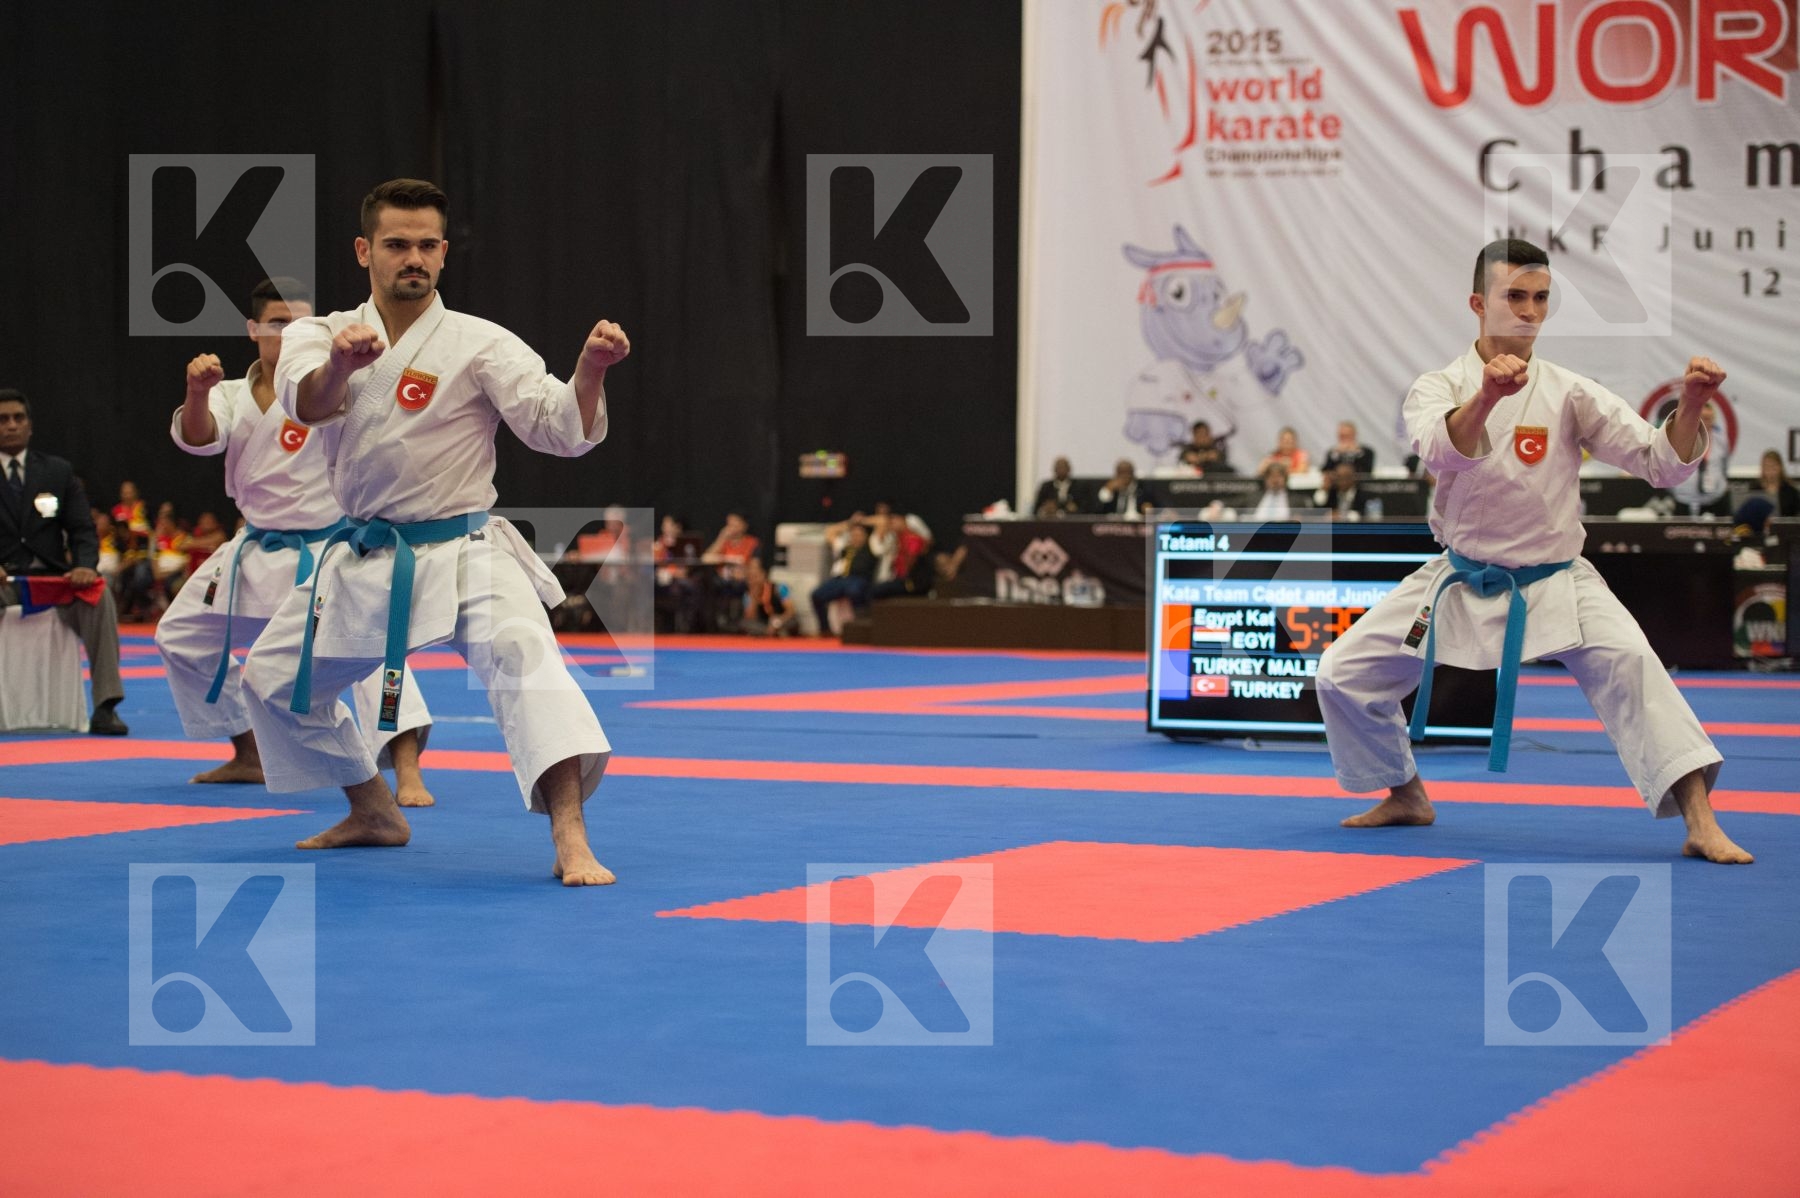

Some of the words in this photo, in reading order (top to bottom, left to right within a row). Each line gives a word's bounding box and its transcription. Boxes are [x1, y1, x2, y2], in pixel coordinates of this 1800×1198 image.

[1206, 29, 1282, 54] 2015
[1205, 67, 1322, 102] world
[1206, 108, 1342, 141] karate
[1741, 267, 1781, 297] 12
[1160, 534, 1215, 551] Tatami
[1217, 535, 1230, 551] 4
[1163, 584, 1199, 602] Kata
[1203, 585, 1247, 602] Team
[1250, 585, 1302, 603] Cadet
[1305, 586, 1338, 602] and
[1340, 586, 1388, 602] Junio
[1193, 608, 1243, 629] Egypt
[1192, 658, 1265, 675] TURKEY
[1268, 659, 1317, 677] MALE
[1231, 680, 1303, 698] TURKEY
